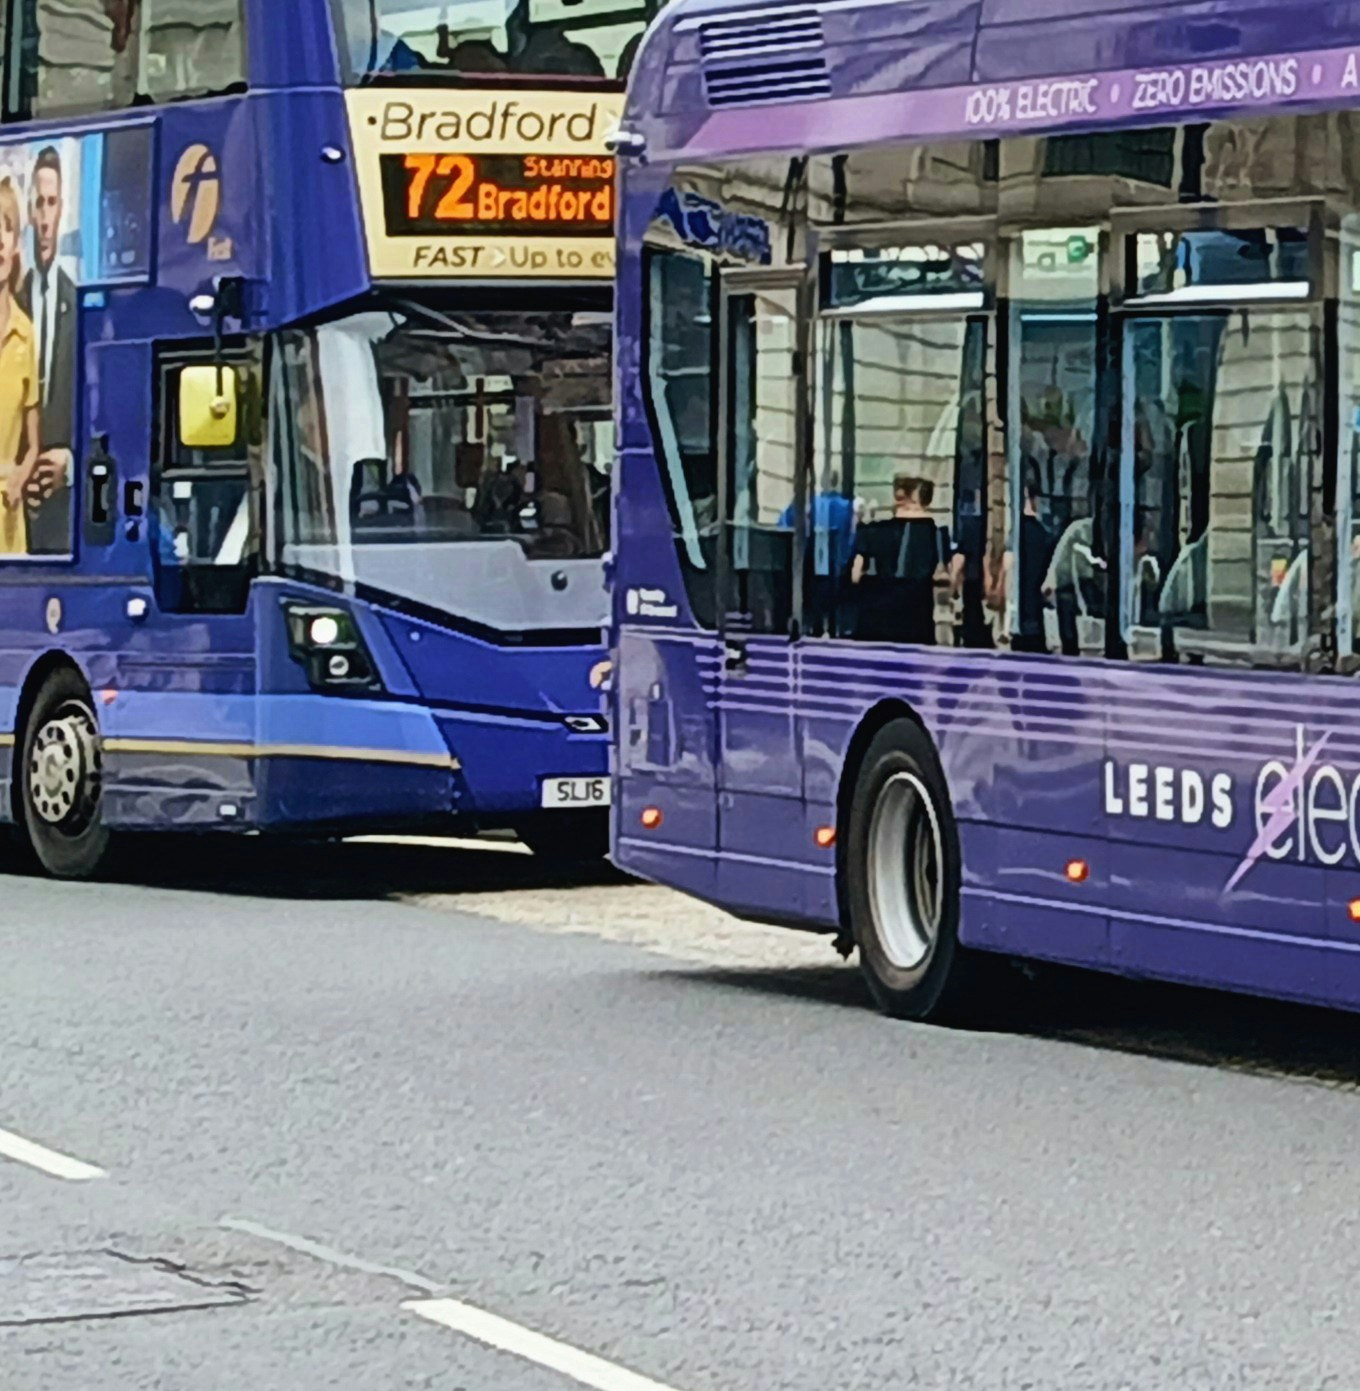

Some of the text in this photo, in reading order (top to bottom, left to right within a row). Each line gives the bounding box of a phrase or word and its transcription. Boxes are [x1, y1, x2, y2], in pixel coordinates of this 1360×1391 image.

[964, 88, 1010, 125] 100%
[1015, 78, 1099, 119] ELECTRIC
[1132, 68, 1185, 110] ZERO
[1188, 58, 1299, 104] EMISSIONS
[1340, 53, 1358, 89] A
[379, 100, 598, 142] Bradford
[403, 153, 475, 220] 72
[477, 182, 611, 221] Bradford
[412, 245, 486, 268] FAST
[508, 245, 548, 269] Up
[555, 248, 583, 268] to
[1104, 760, 1233, 828] LEEDS
